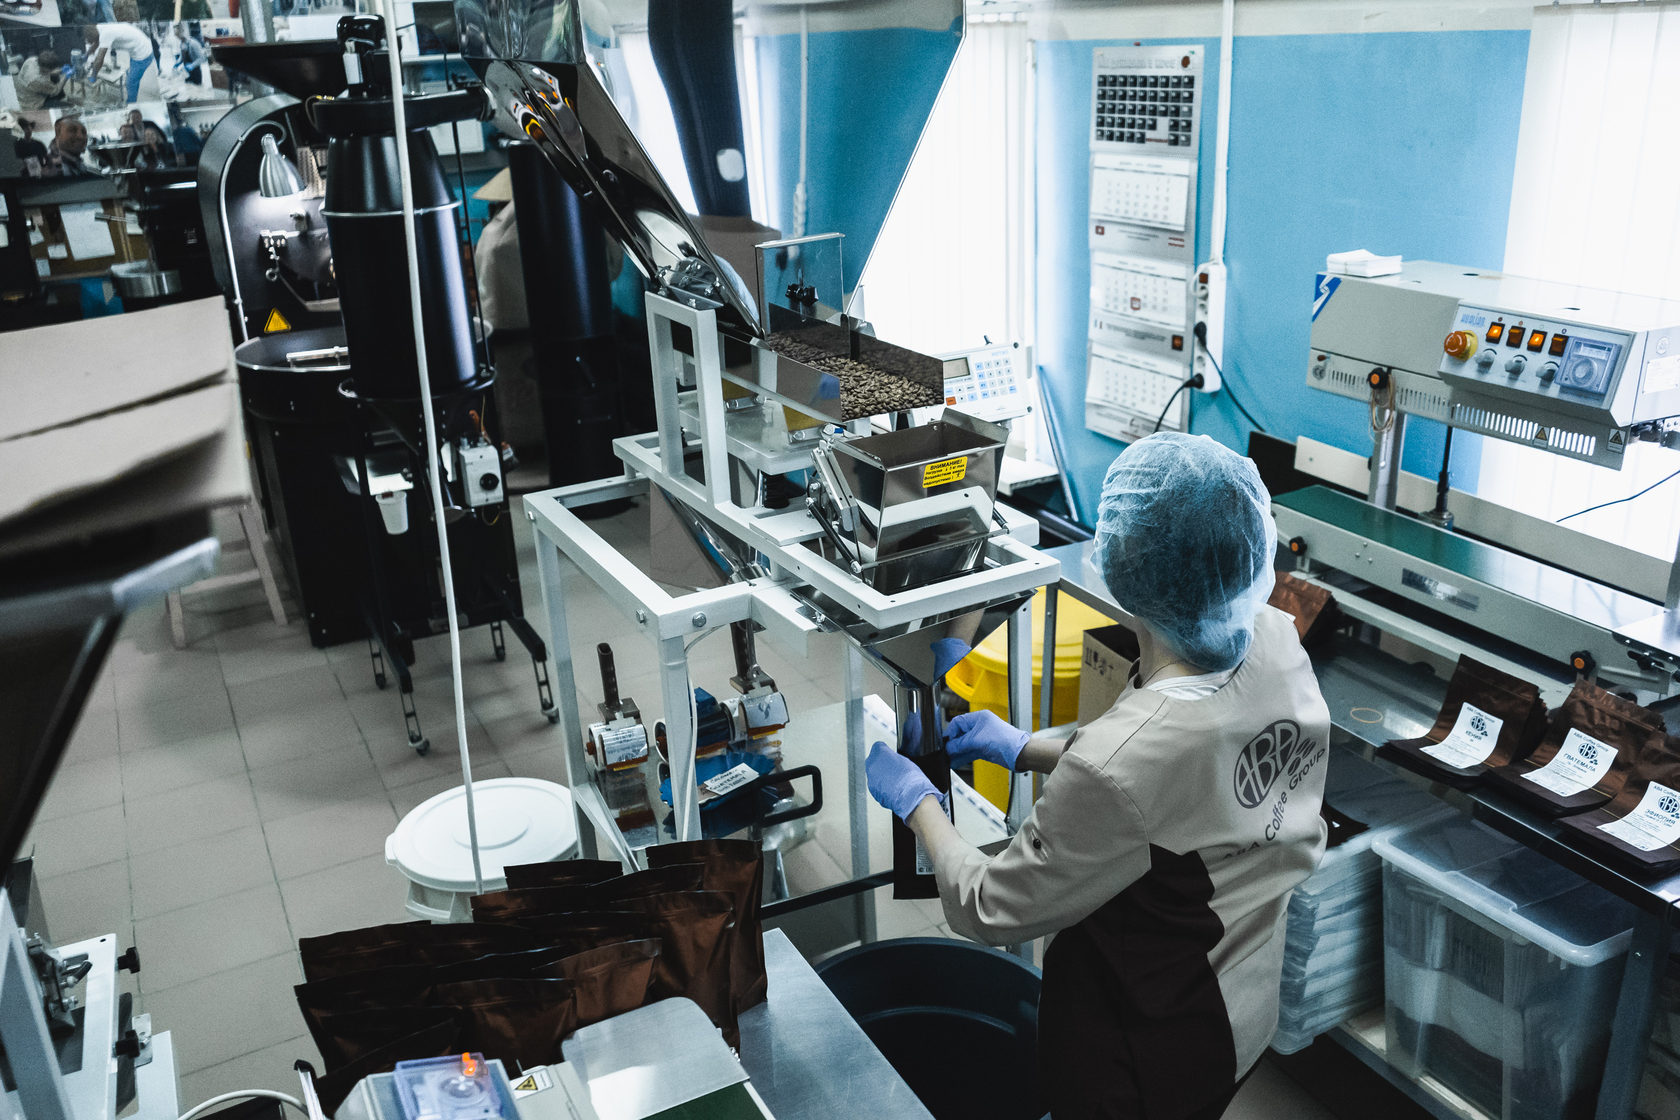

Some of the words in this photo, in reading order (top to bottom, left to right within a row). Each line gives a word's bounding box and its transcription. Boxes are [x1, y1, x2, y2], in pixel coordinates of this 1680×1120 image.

[930, 459, 962, 470] ВНИМАНИЕ!
[1234, 719, 1300, 809] ABA
[1564, 753, 1596, 772] ГВАТЕМАЛА
[1646, 808, 1676, 824] ЭФИОПИЯ
